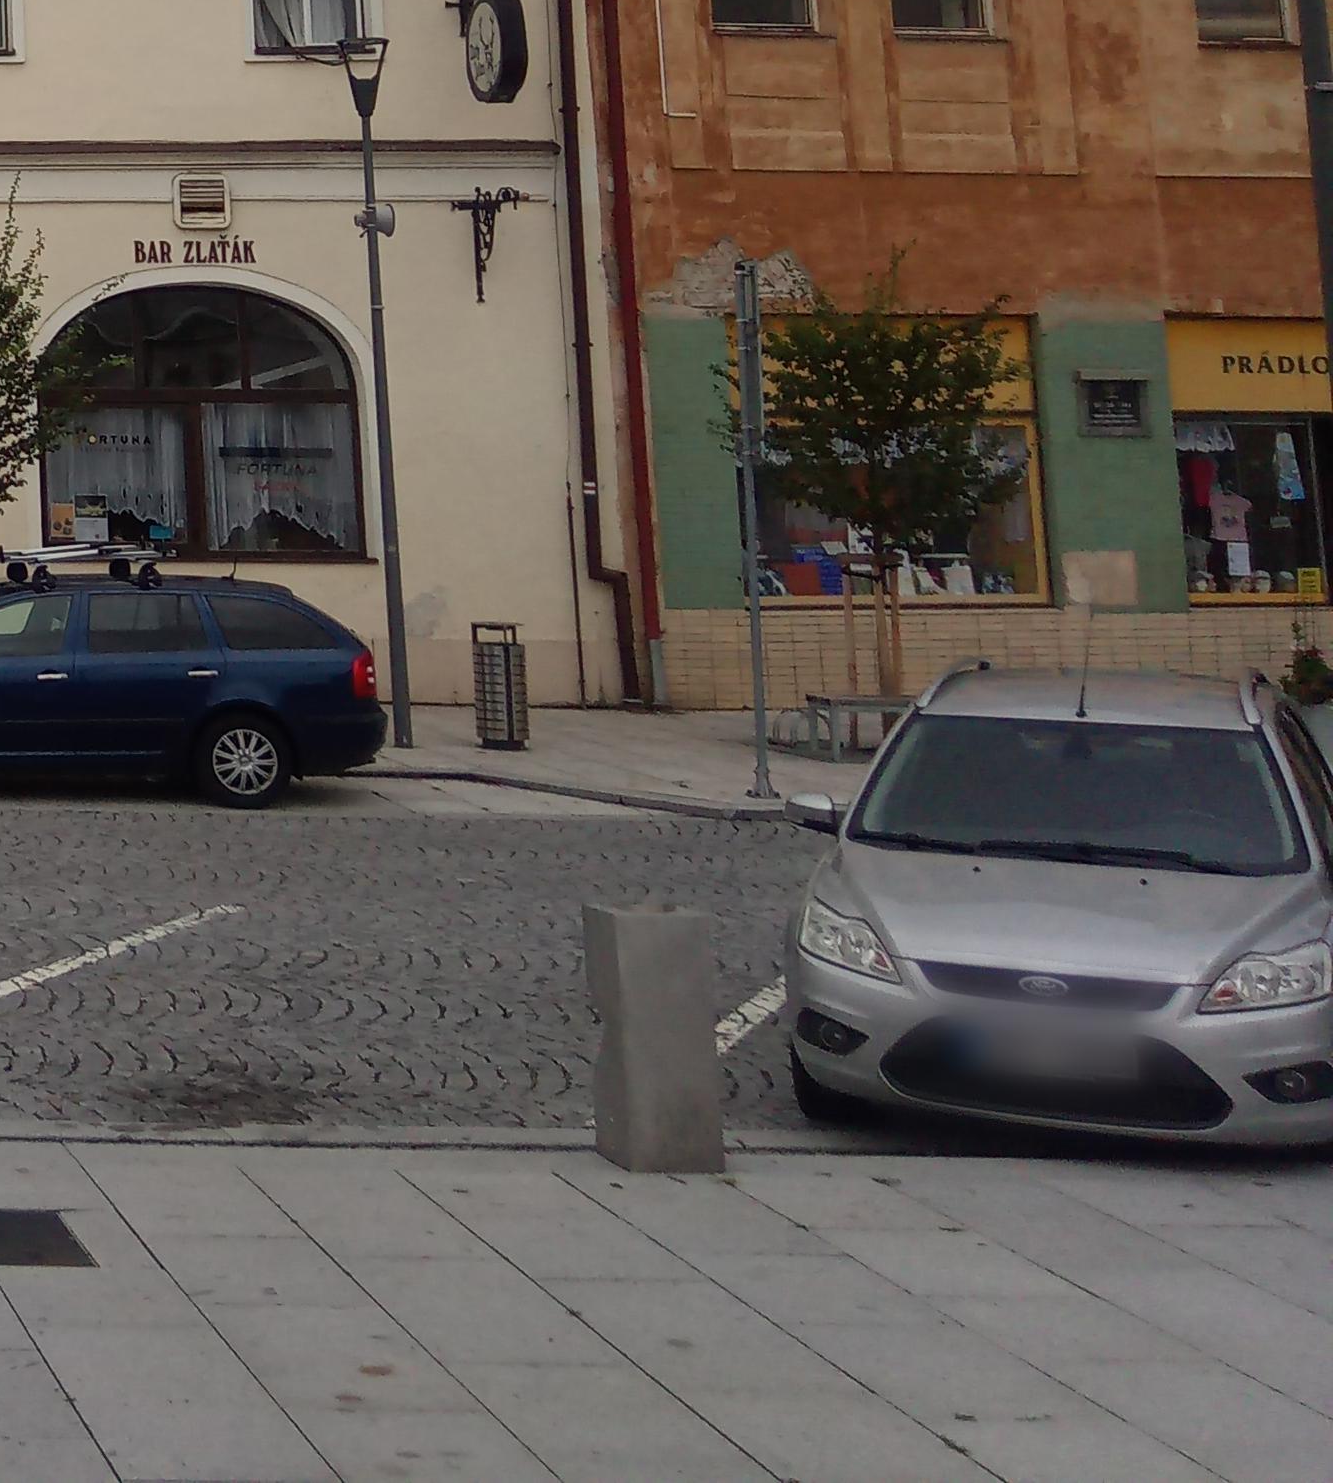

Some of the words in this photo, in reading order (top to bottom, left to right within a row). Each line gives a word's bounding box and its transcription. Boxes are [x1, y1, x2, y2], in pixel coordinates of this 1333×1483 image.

[133, 239, 173, 264] BAR
[182, 233, 257, 264] ZLAŤÁK
[1220, 349, 1330, 375] PRÁDLO
[77, 433, 152, 446] ORTUNA
